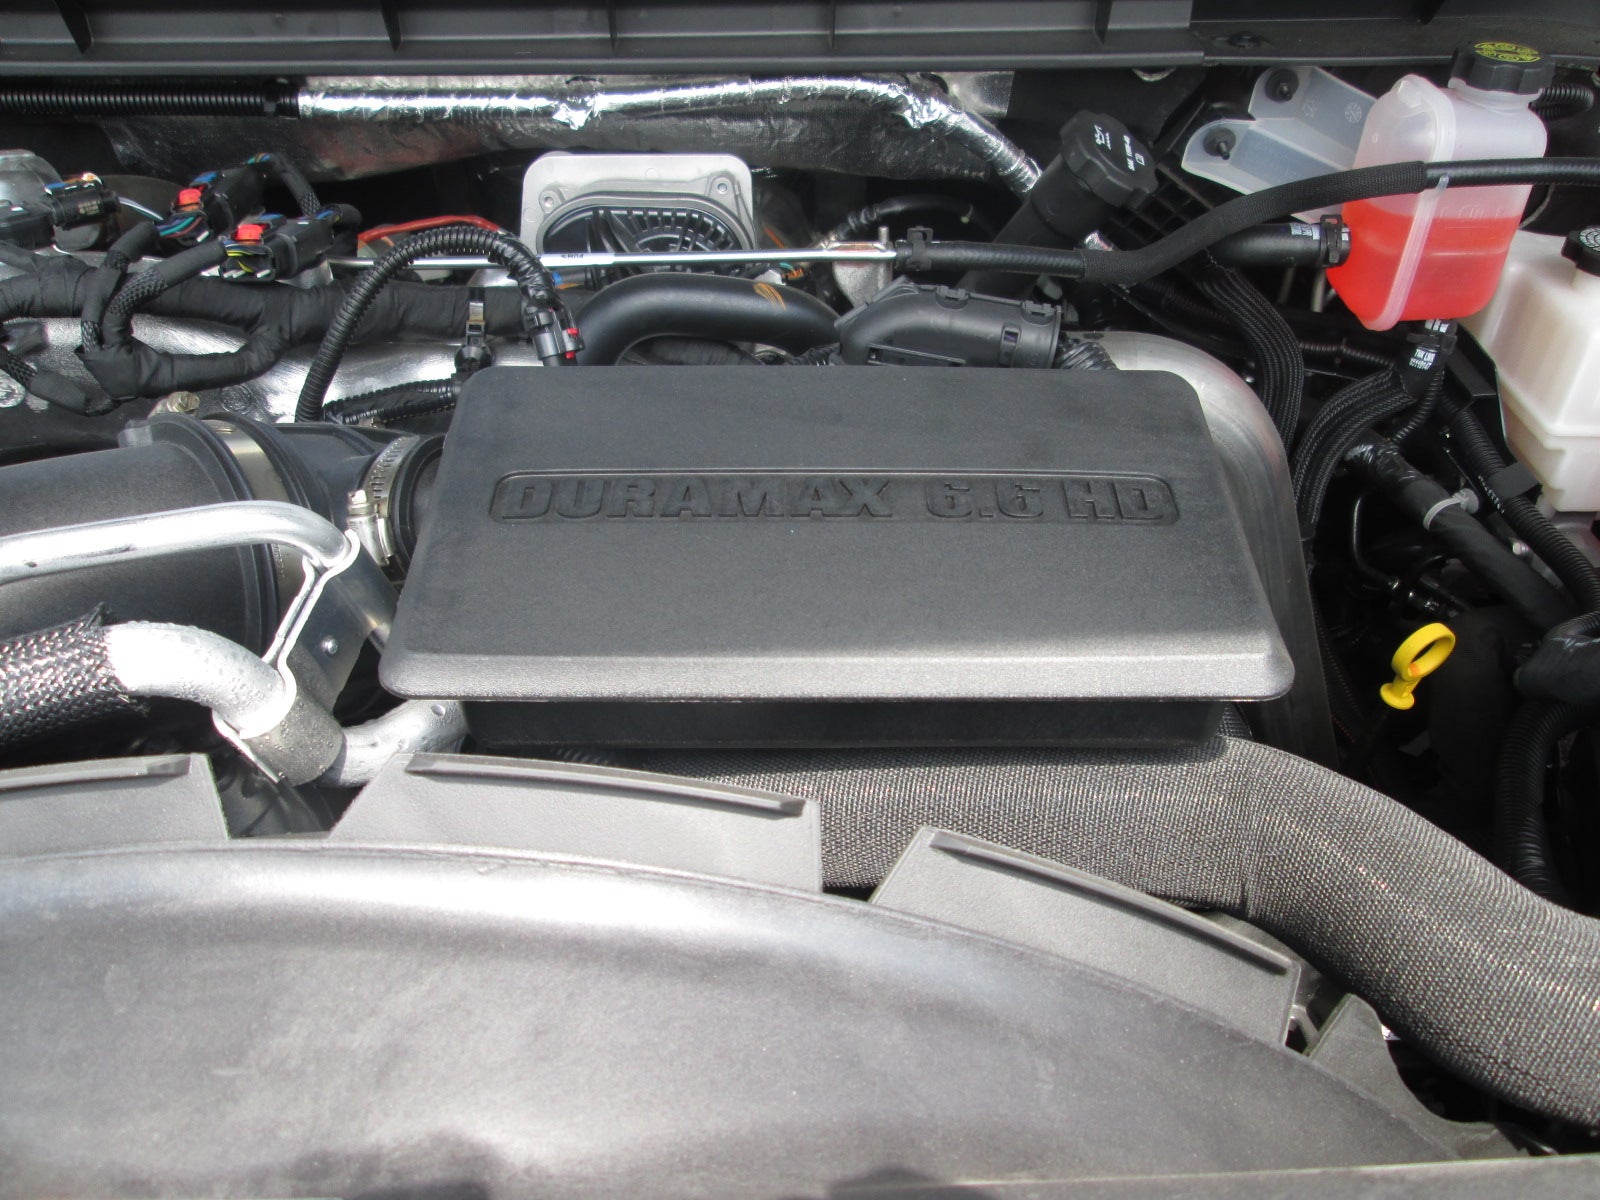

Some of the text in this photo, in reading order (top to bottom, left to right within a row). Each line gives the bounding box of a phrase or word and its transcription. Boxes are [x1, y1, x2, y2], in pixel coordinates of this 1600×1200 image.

[500, 478, 1166, 521] DURAMAX 6.6 HD
